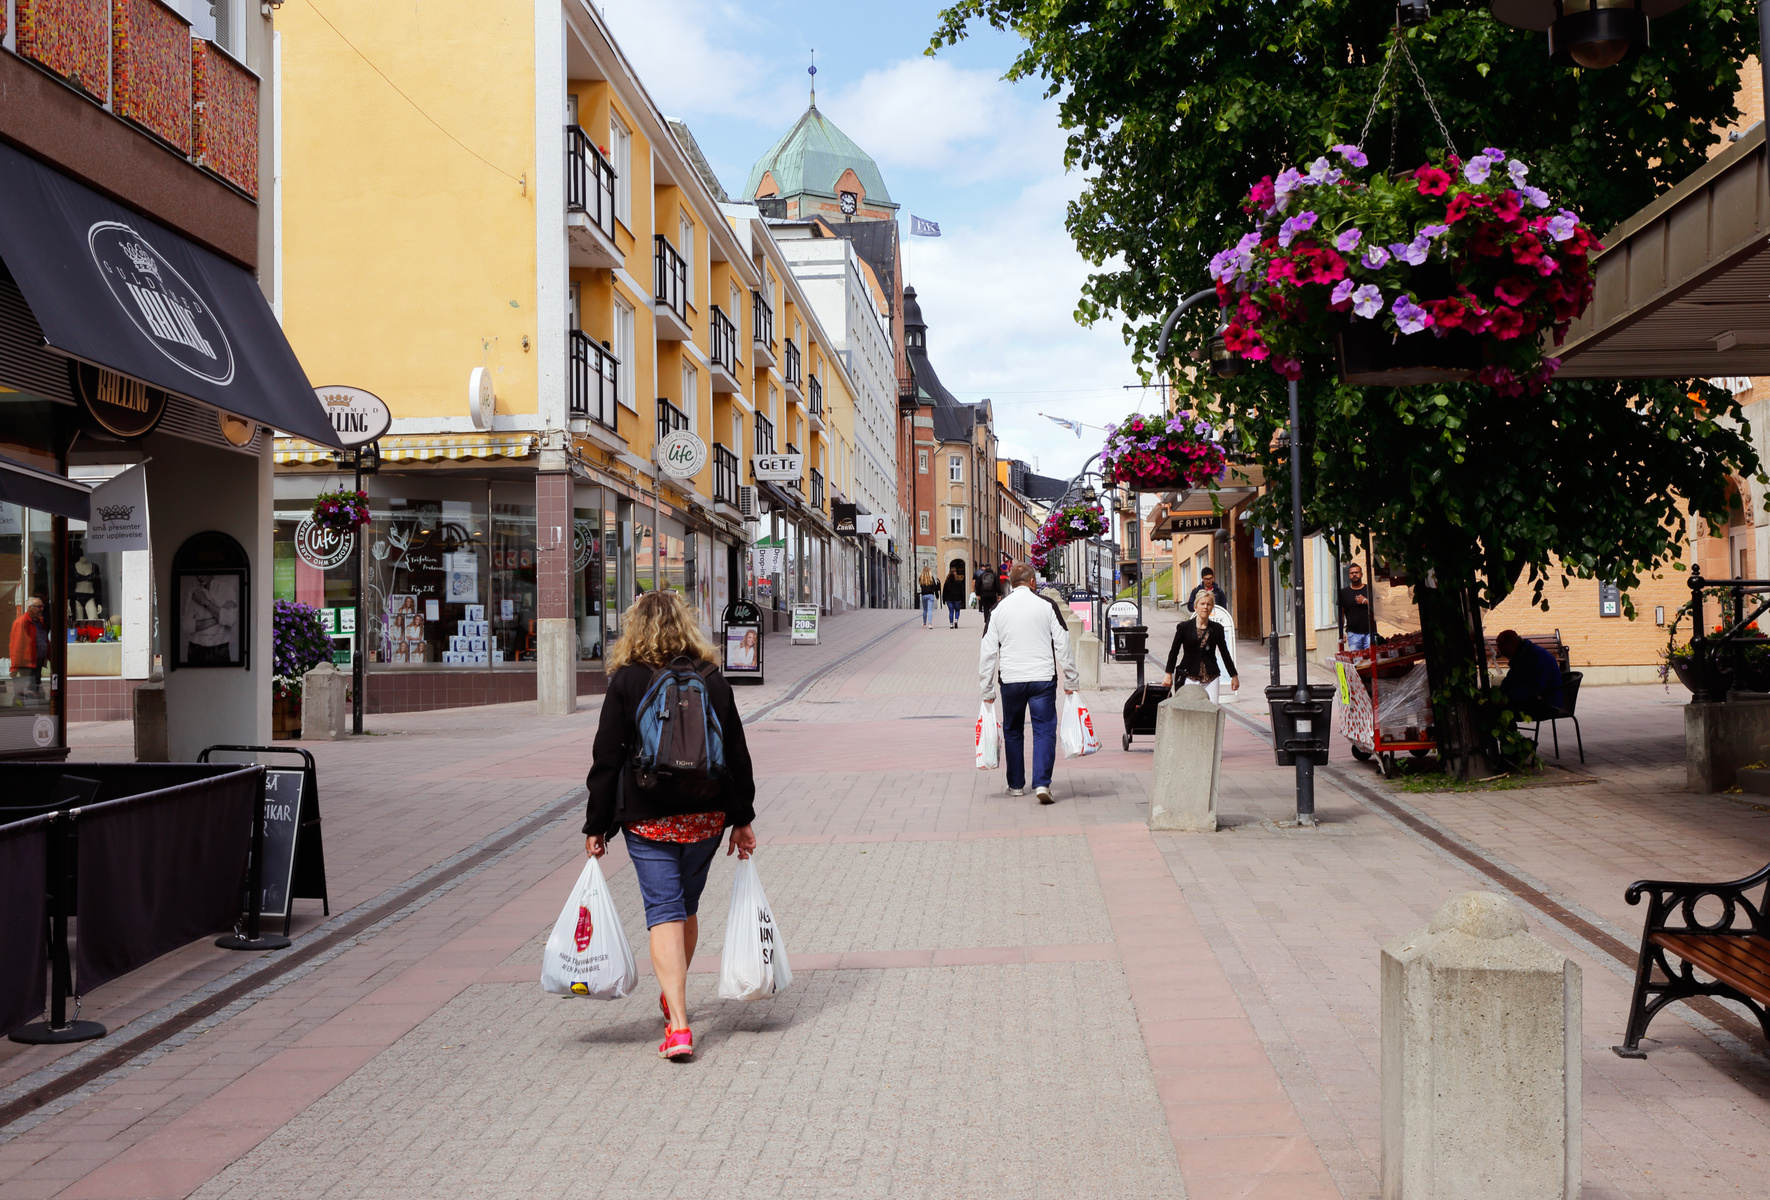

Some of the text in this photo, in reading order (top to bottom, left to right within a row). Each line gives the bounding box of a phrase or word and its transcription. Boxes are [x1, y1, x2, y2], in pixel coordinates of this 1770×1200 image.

[330, 406, 379, 414] DSMED
[329, 412, 368, 433] LING
[669, 444, 694, 463] life
[92, 523, 142, 532] små presenter
[1178, 517, 1214, 528] FANNY
[106, 531, 143, 540] upplevelse
[311, 527, 339, 550] life
[299, 543, 312, 560] CARE
[330, 542, 350, 563] PEOPLE
[313, 558, 330, 566] WHO
[734, 605, 751, 619] life
[263, 804, 292, 822] IKAR
